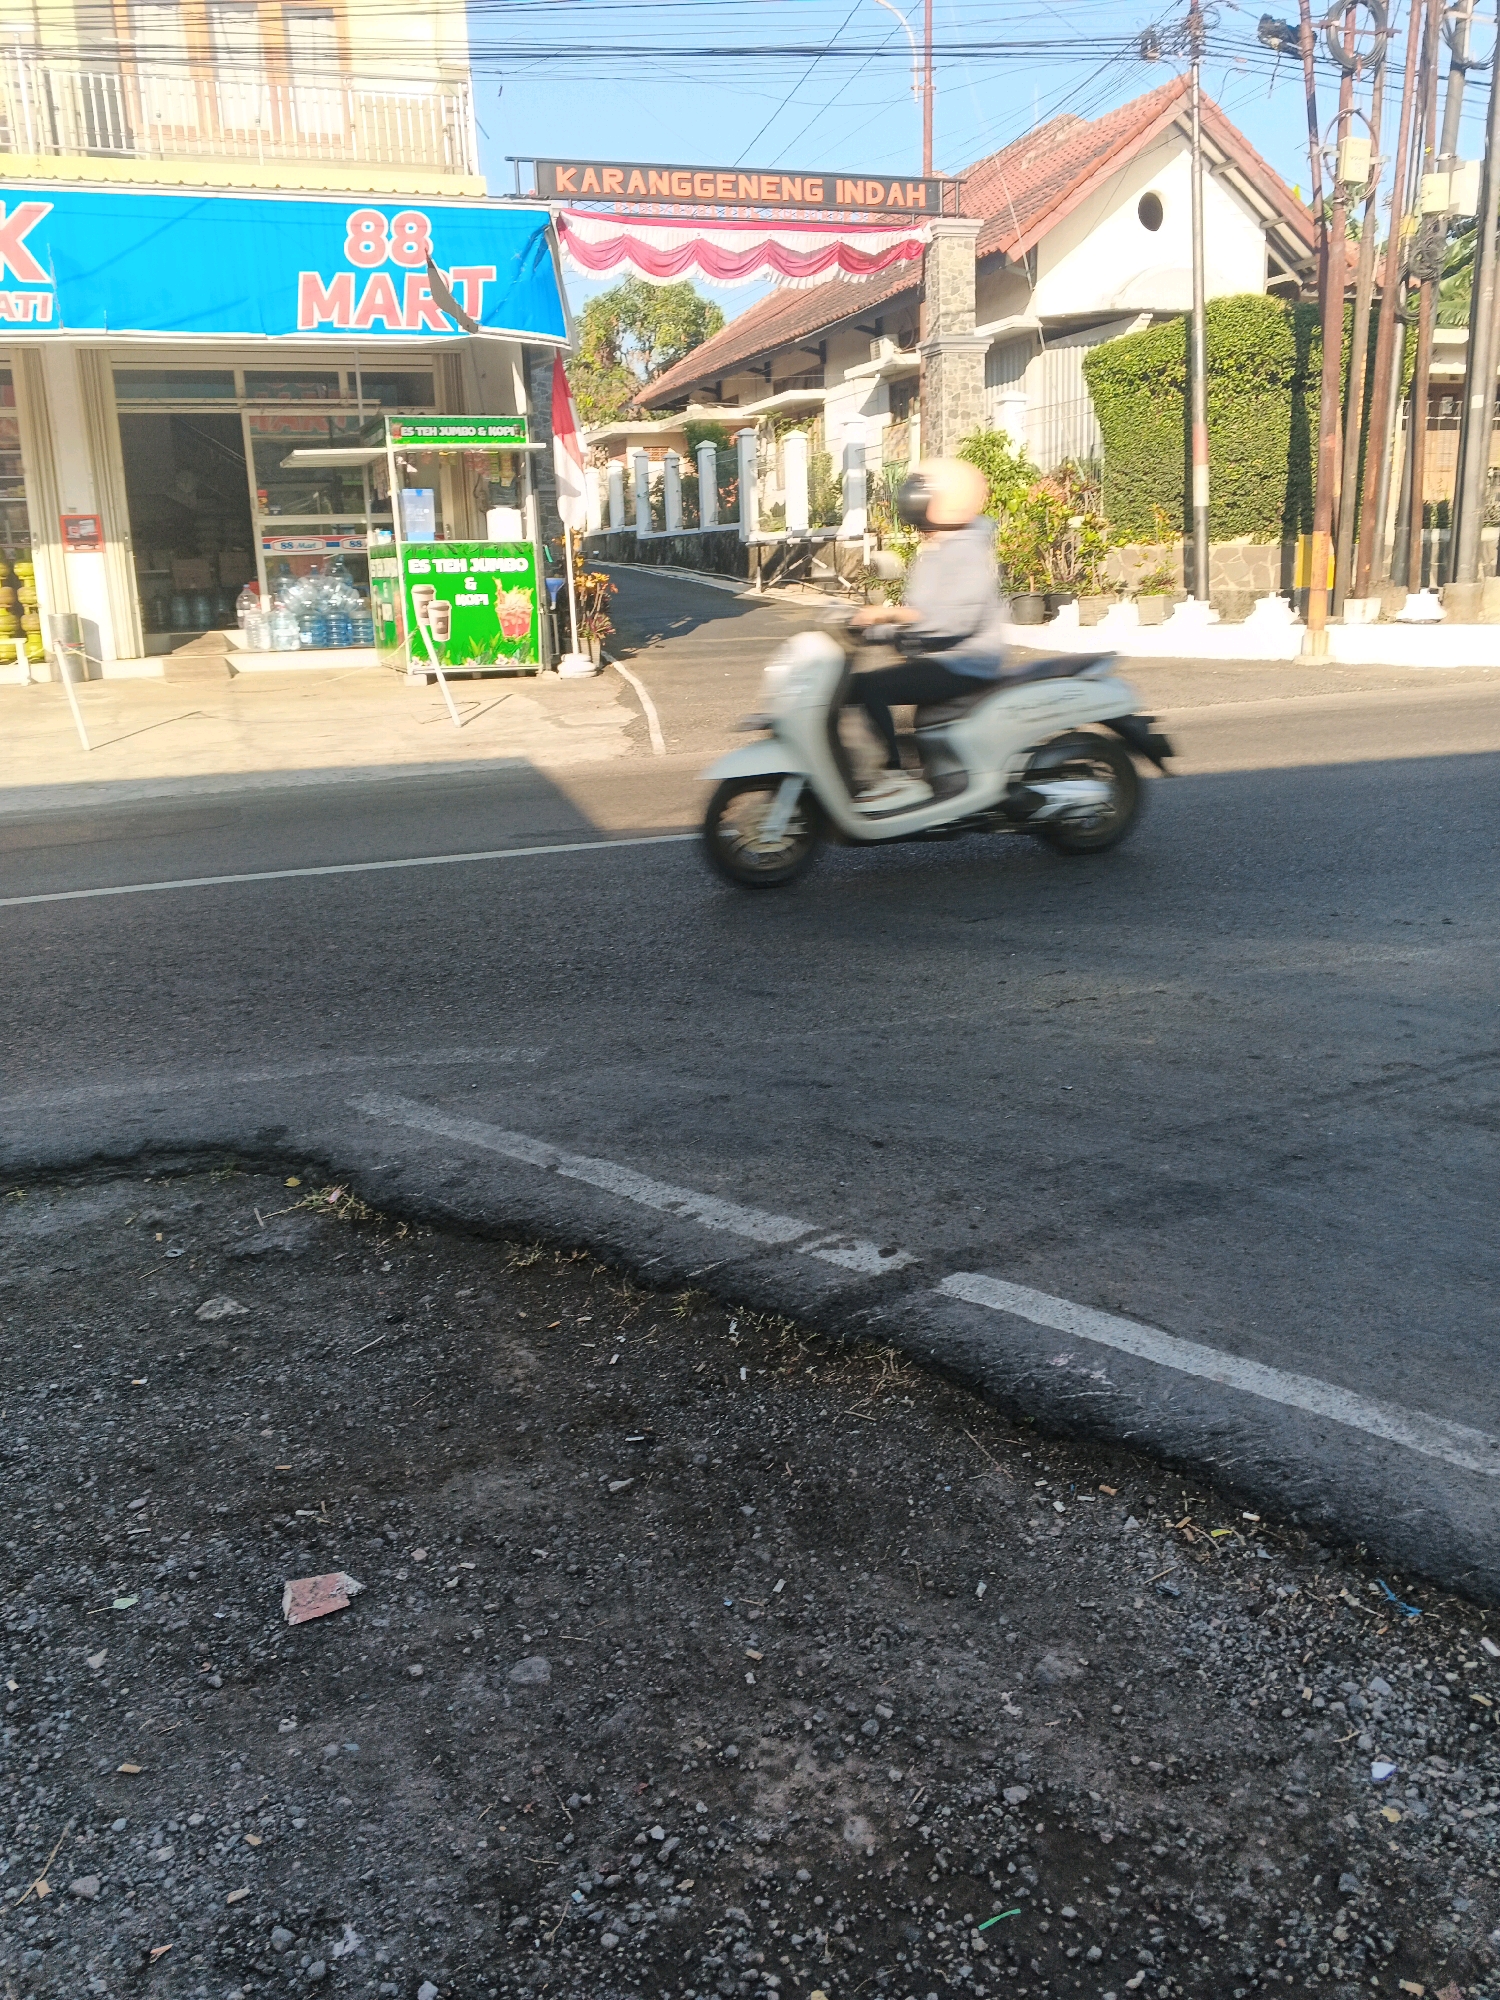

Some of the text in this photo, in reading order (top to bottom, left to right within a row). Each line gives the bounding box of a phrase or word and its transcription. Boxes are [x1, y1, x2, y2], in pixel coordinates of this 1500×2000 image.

[555, 166, 926, 208] KARANGGENENG INDAH
[344, 208, 433, 268] 88
[298, 265, 496, 332] MART
[401, 426, 515, 437] ES TEH JUMBO & KOPI
[280, 542, 294, 550] 88
[349, 540, 363, 548] 88
[408, 558, 431, 574] ES
[432, 558, 467, 573] TEH
[470, 557, 529, 573] JUMBO
[464, 577, 477, 591] &
[455, 593, 489, 607] KOPI
